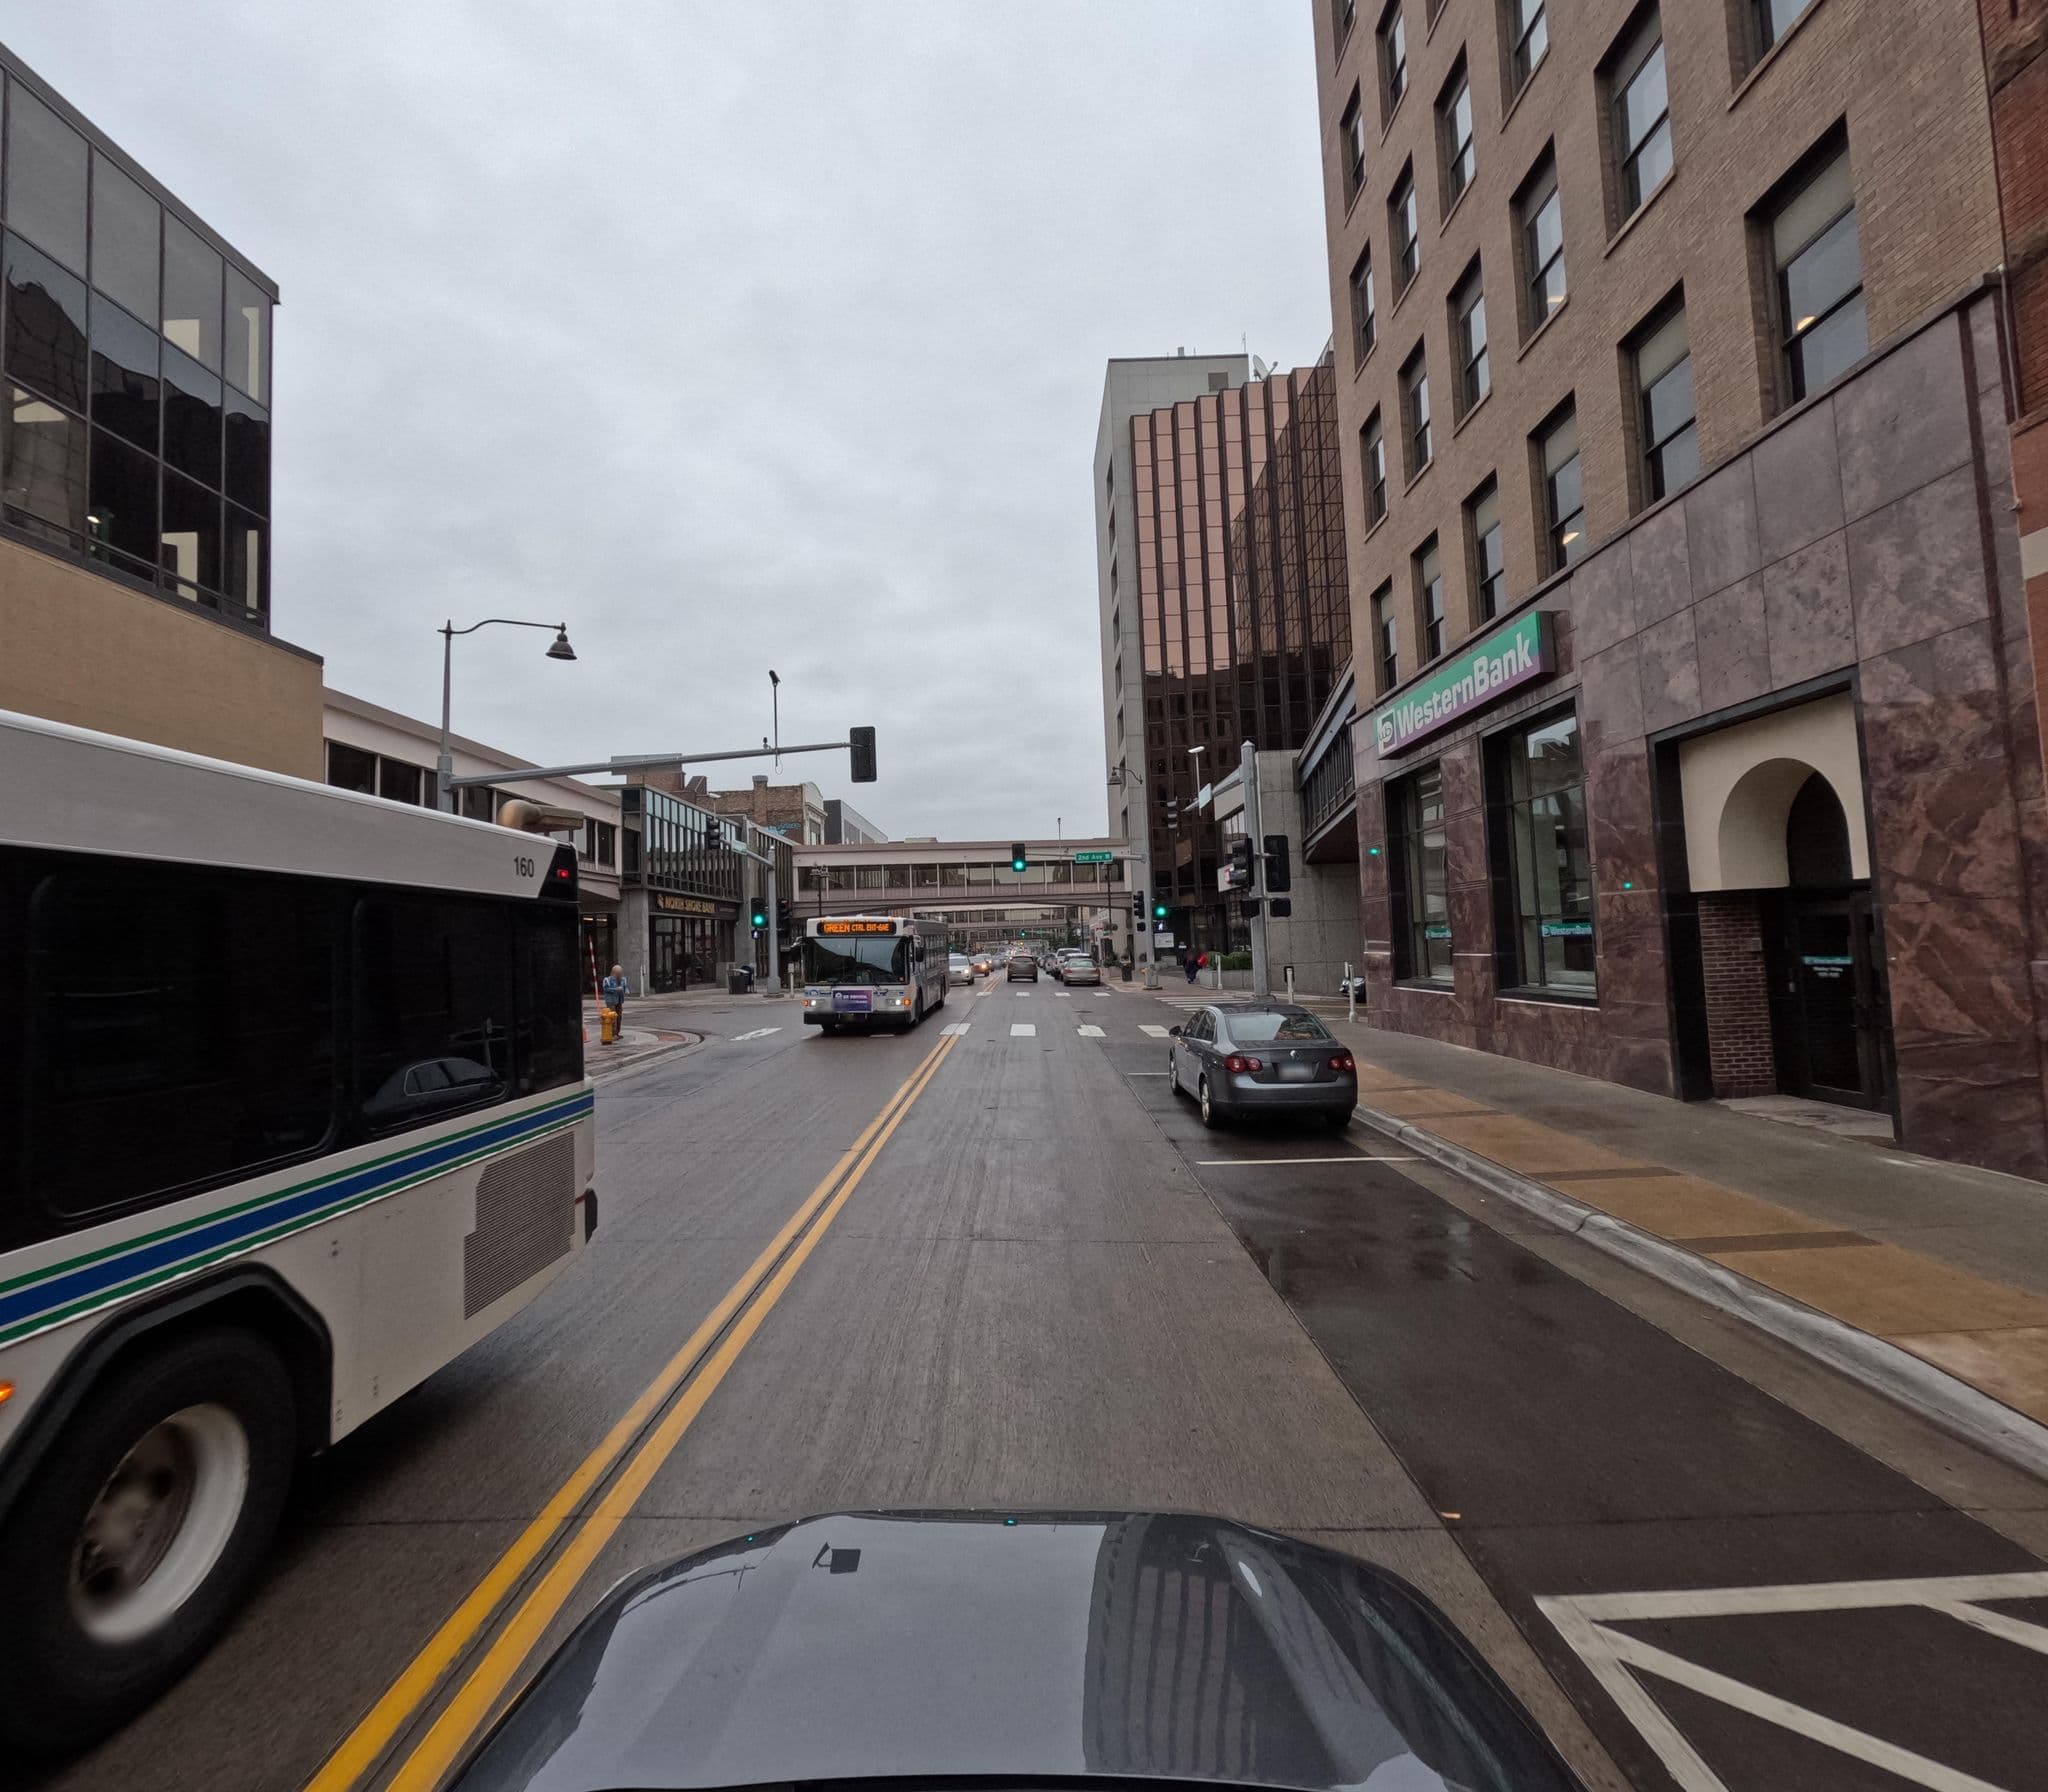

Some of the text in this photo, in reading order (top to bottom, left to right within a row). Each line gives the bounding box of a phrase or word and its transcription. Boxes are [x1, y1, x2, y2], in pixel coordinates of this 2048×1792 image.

[1397, 632, 1533, 739] WesternBank
[513, 856, 535, 878] 160
[824, 923, 850, 933] GREEN
